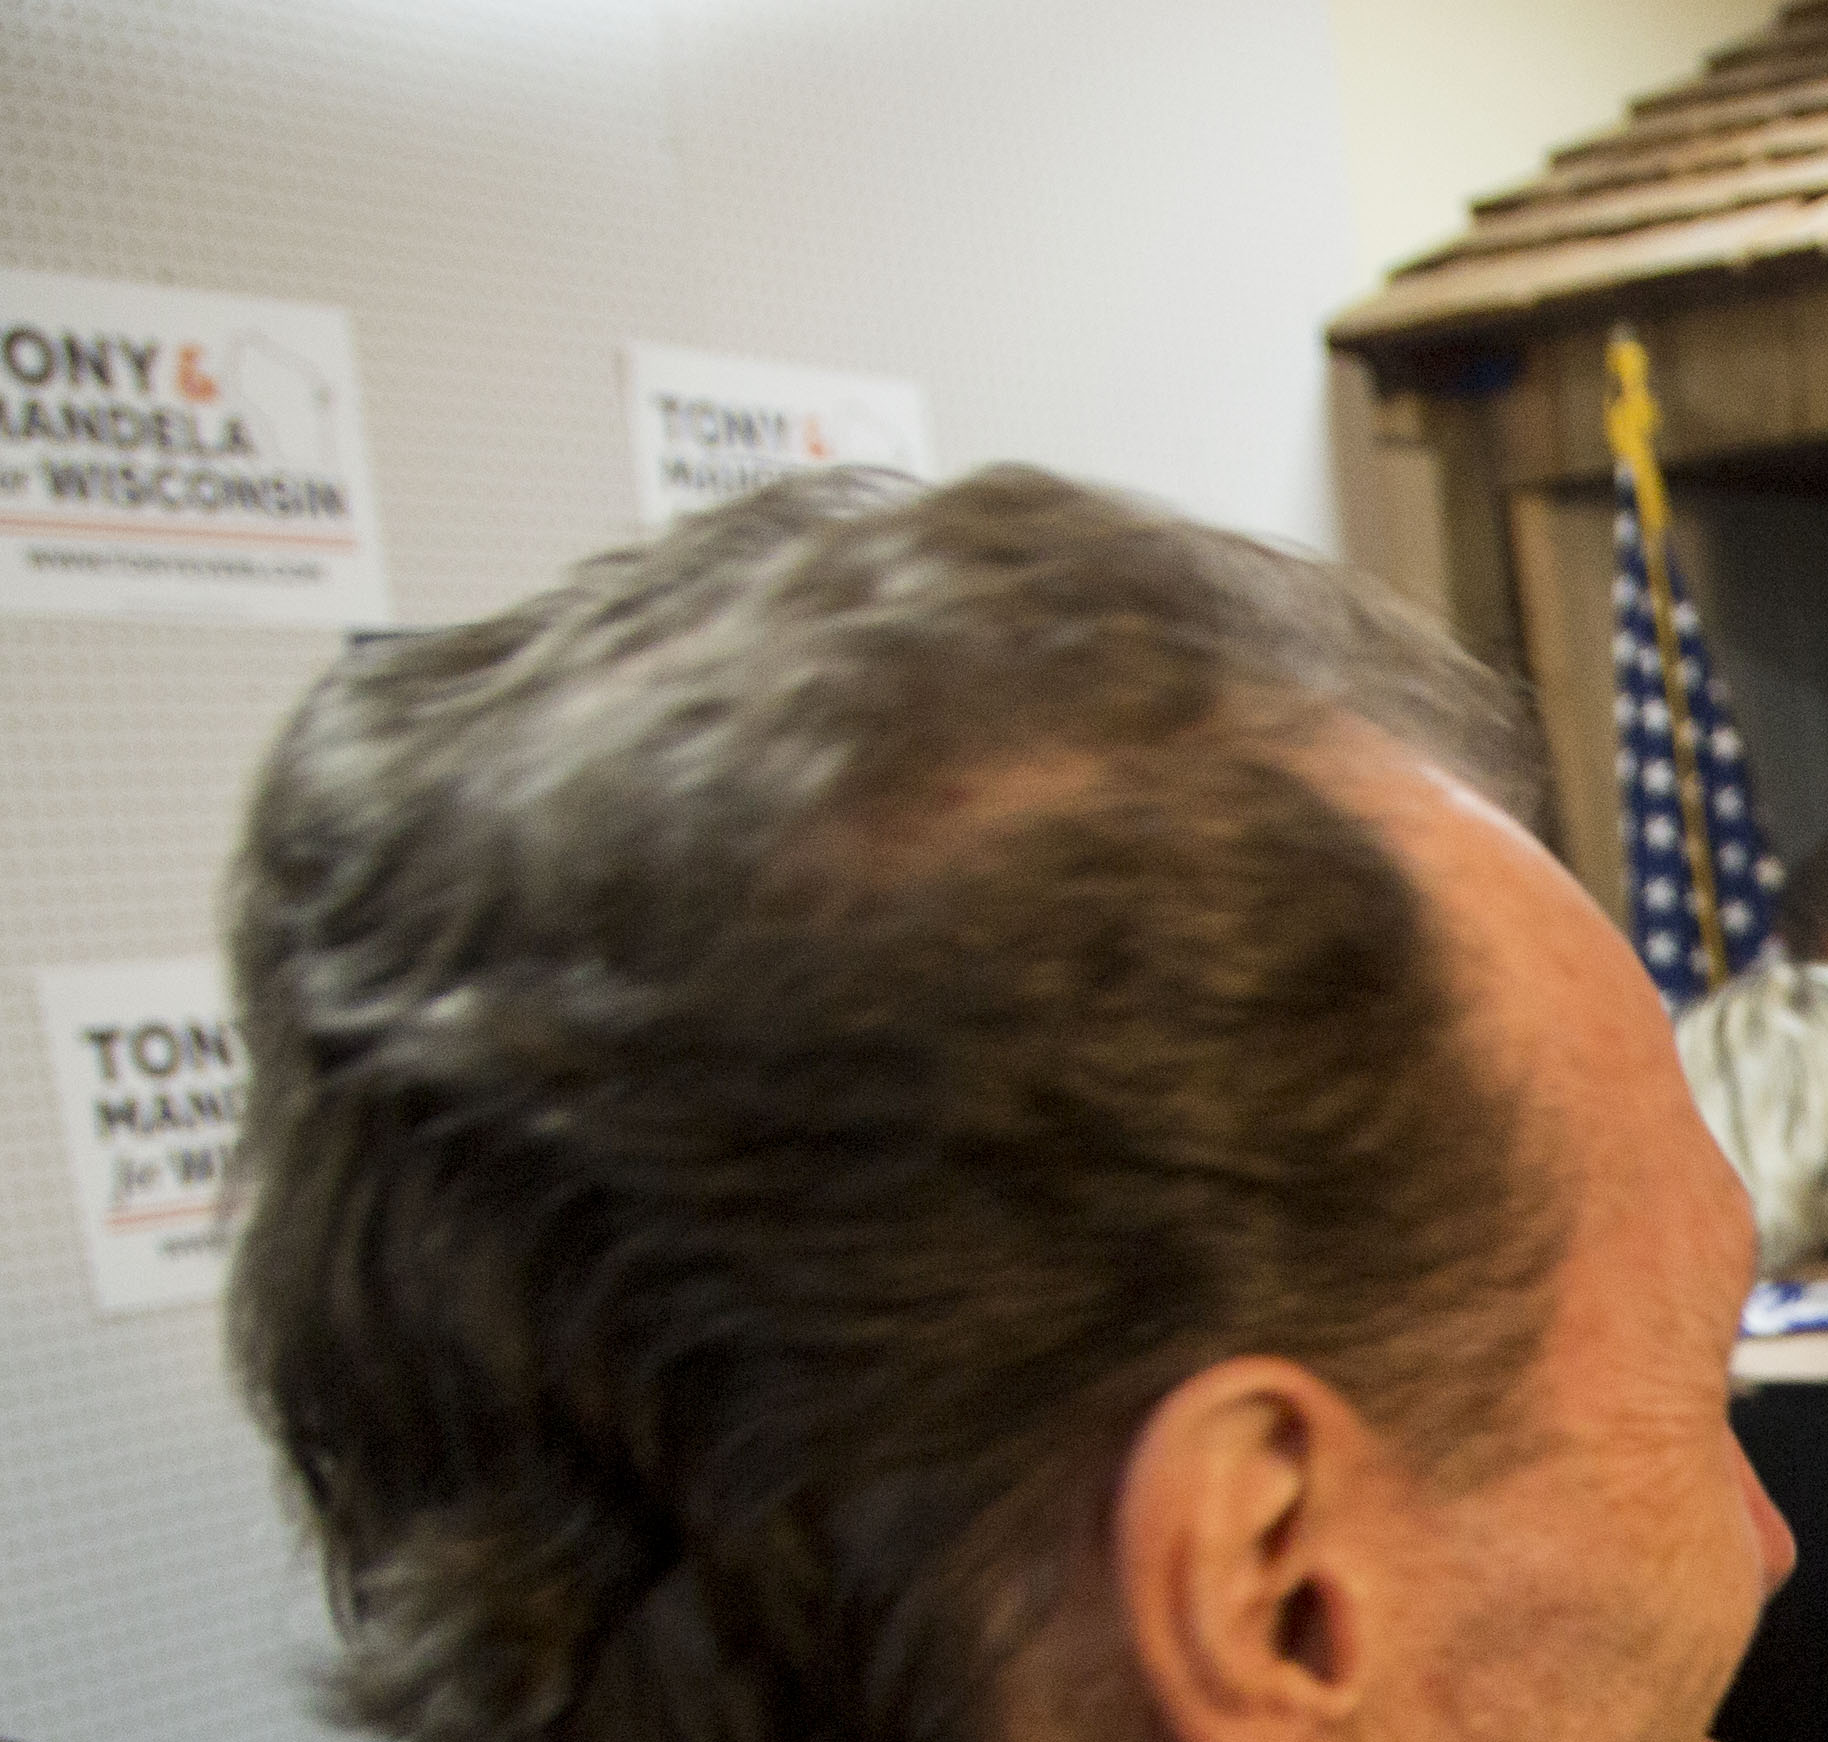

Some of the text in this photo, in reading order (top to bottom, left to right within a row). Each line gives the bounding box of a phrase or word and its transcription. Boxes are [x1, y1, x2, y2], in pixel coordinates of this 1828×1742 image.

[0, 325, 163, 392] ONY
[40, 458, 350, 520] WISCONSIN
[78, 1018, 242, 1084] TON
